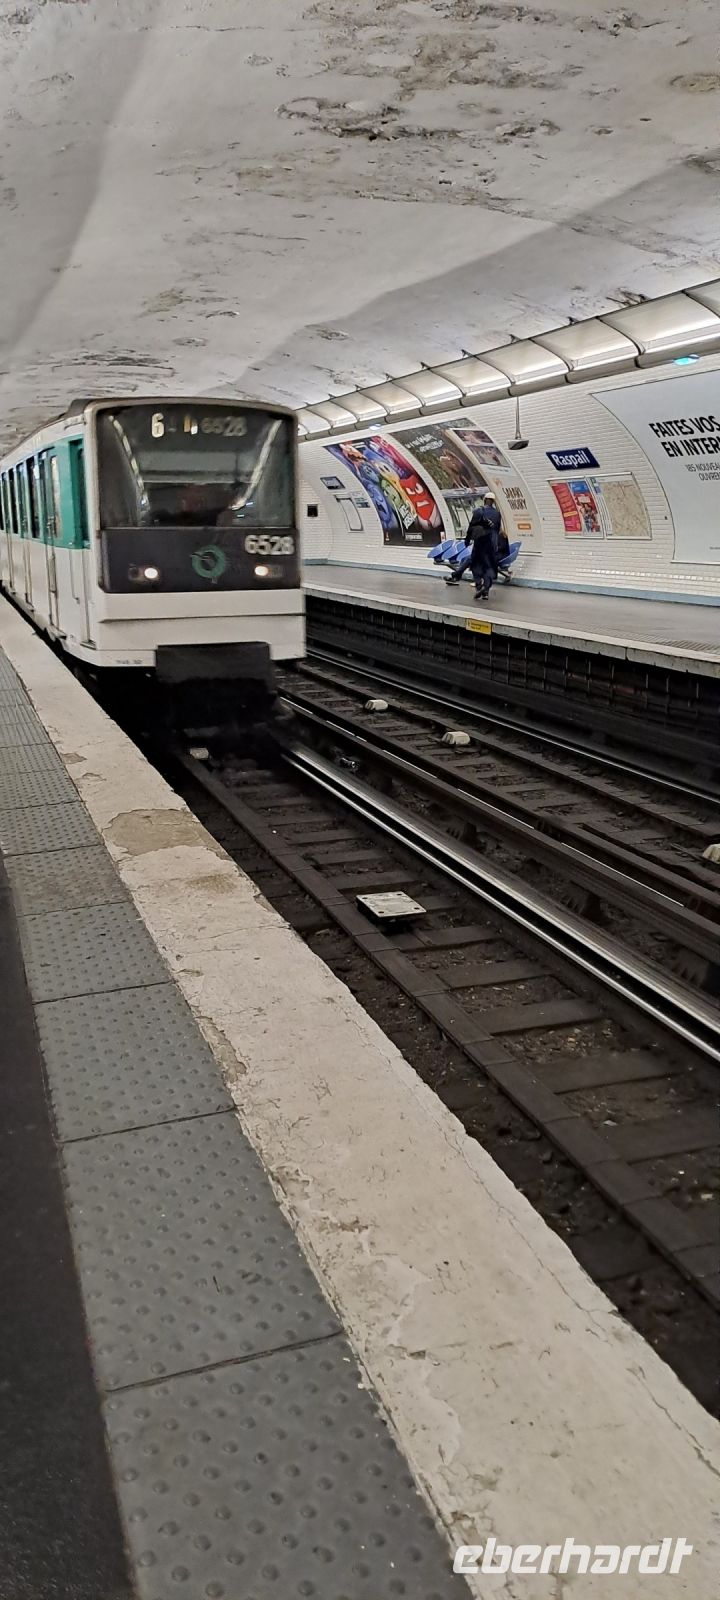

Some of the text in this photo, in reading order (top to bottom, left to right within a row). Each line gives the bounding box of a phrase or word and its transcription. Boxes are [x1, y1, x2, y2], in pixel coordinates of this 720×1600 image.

[151, 412, 165, 438] 6
[648, 415, 720, 438] FAITES VOS
[550, 450, 591, 469] Raspail
[660, 440, 684, 457] EN
[244, 534, 295, 556] 6528
